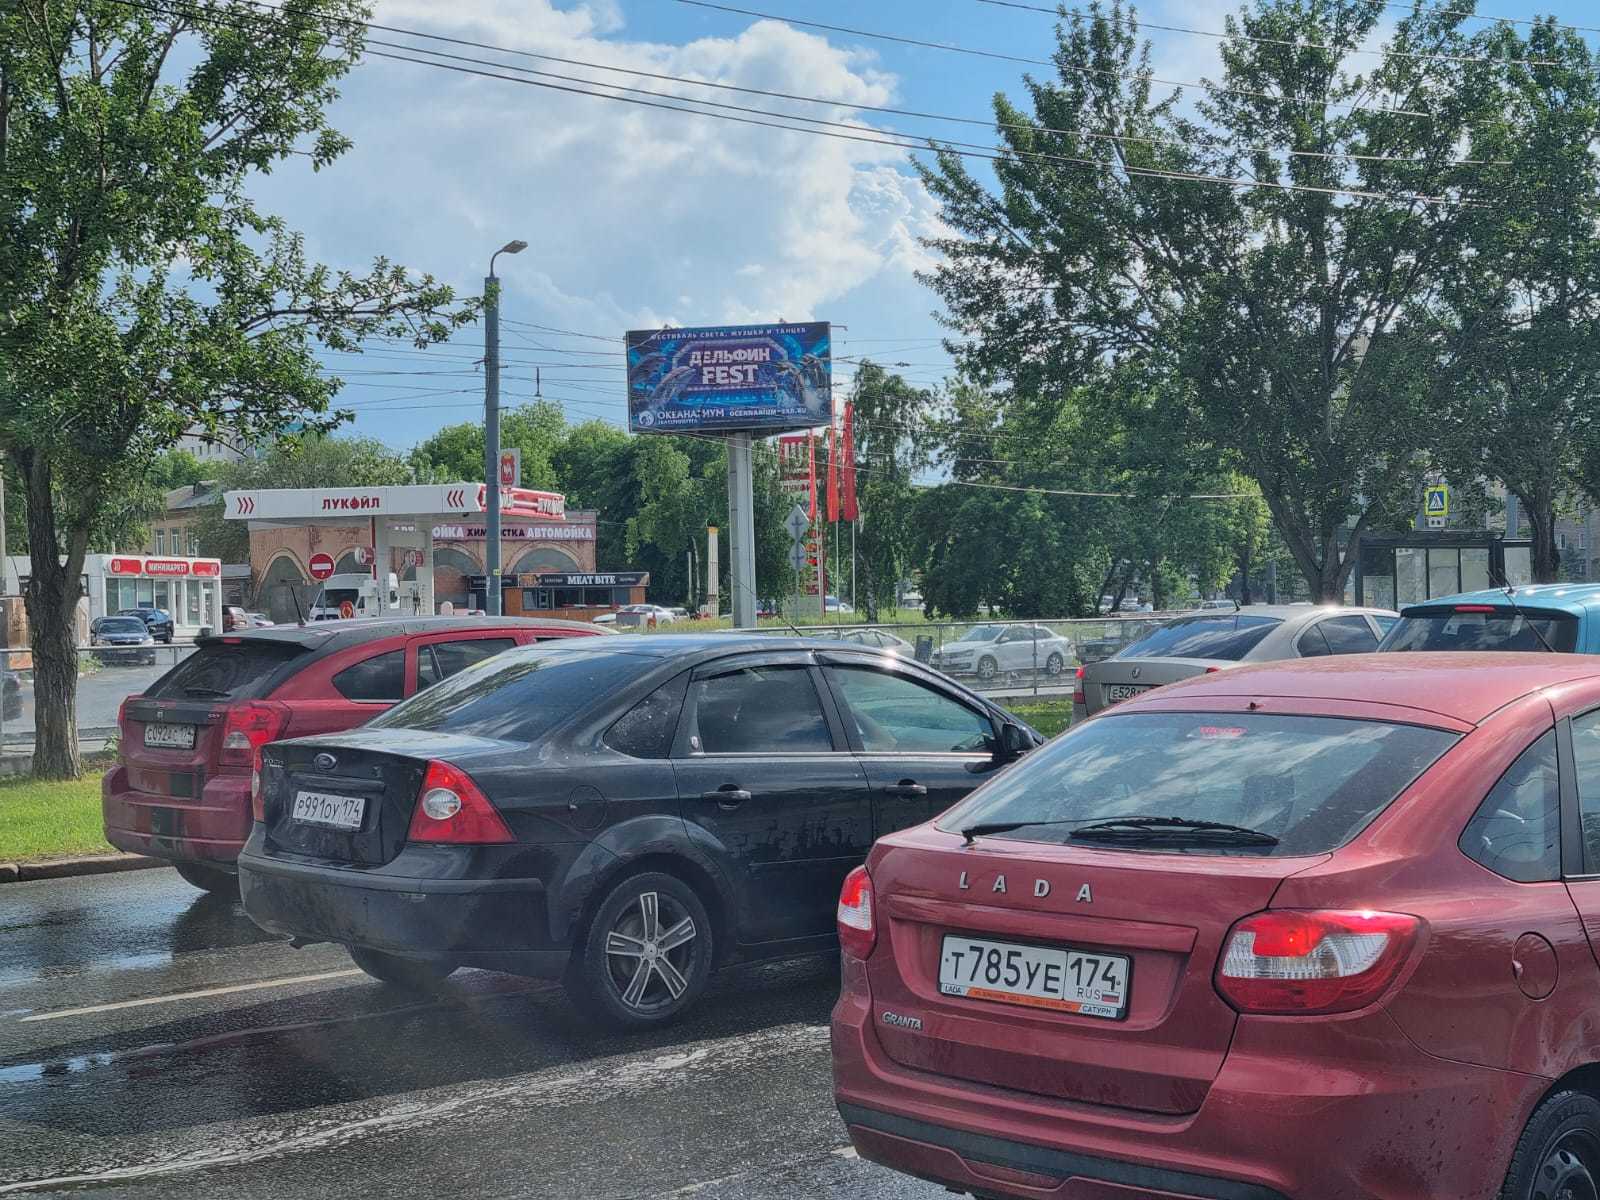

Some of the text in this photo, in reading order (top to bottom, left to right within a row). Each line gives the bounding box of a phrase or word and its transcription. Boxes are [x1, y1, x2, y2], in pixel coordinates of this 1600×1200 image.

[689, 348, 771, 367] ДЕЛЬФИН
[702, 364, 758, 385] FEST
[322, 496, 379, 510] ЛУКОЙЛ
[526, 525, 593, 540] АВТОМОЙКА
[567, 575, 594, 585] MEAT
[594, 575, 616, 585] BITE
[342, 799, 361, 817] 174
[959, 871, 1092, 903] LADA
[951, 945, 1117, 994] Т785УЕ 174
[944, 984, 963, 995] LADA
[1077, 987, 1101, 1001] RUS
[1082, 1005, 1112, 1016] САТУРН
[882, 1011, 922, 1031] GRANTA
